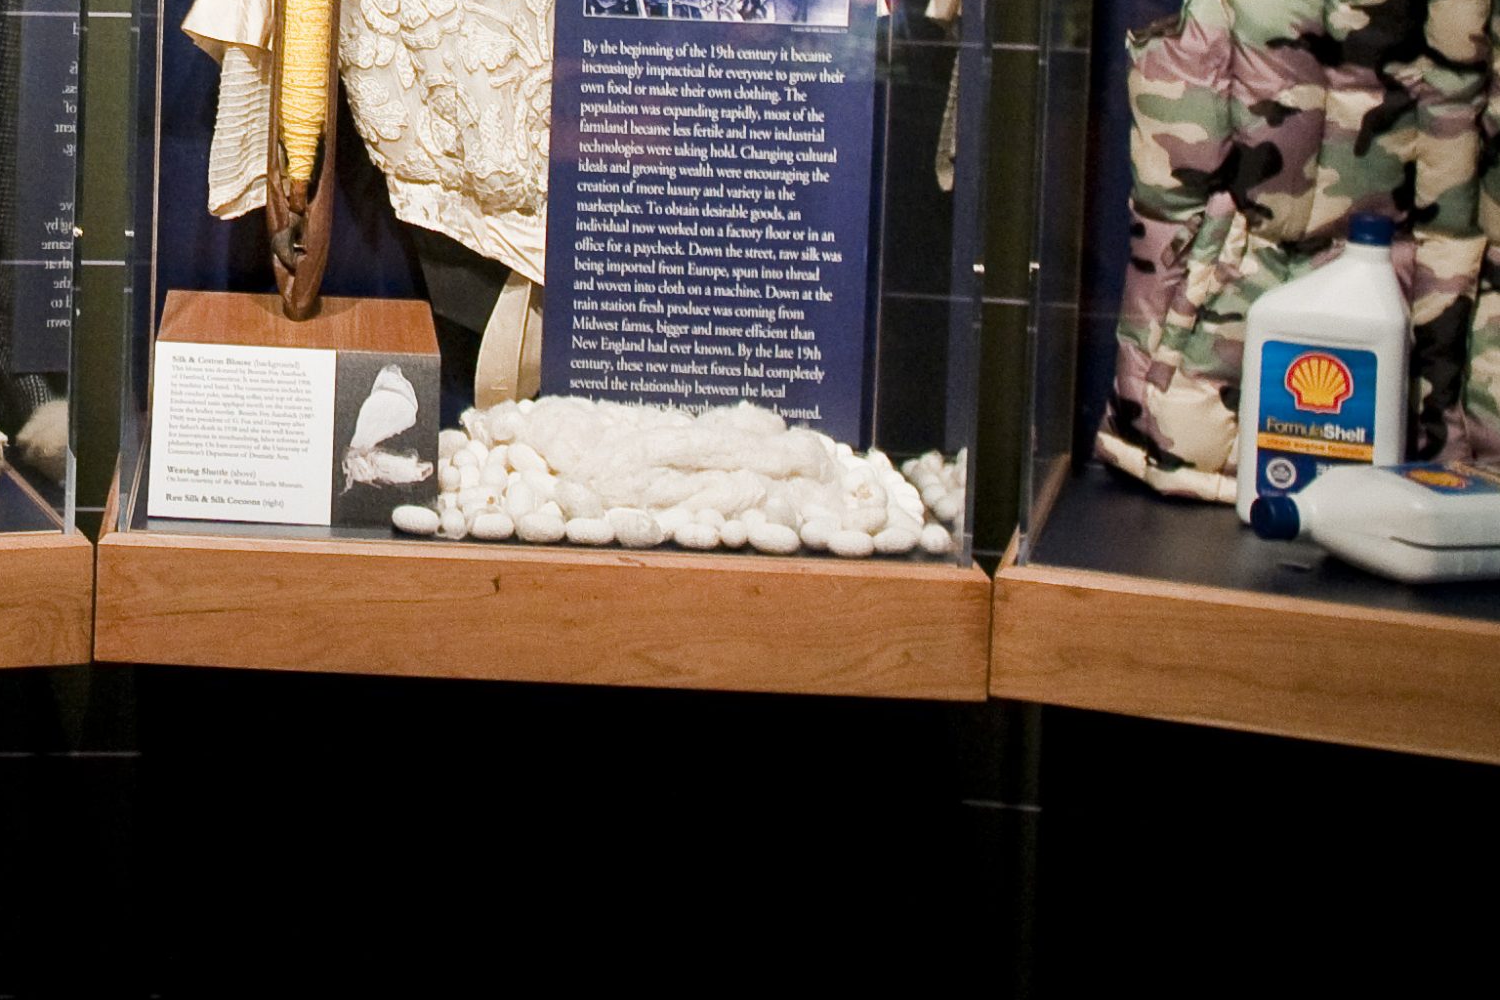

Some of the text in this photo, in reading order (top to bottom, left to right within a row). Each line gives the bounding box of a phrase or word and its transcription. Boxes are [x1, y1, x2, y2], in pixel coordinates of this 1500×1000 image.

[583, 38, 832, 64] By the beginning of the 19th century it became
[580, 99, 824, 123] population was expanding rapidly, most of the
[576, 198, 801, 223] marketplace. To obtain desirable goods, an
[572, 315, 815, 340] Midwest farms, bigger and more efficient than
